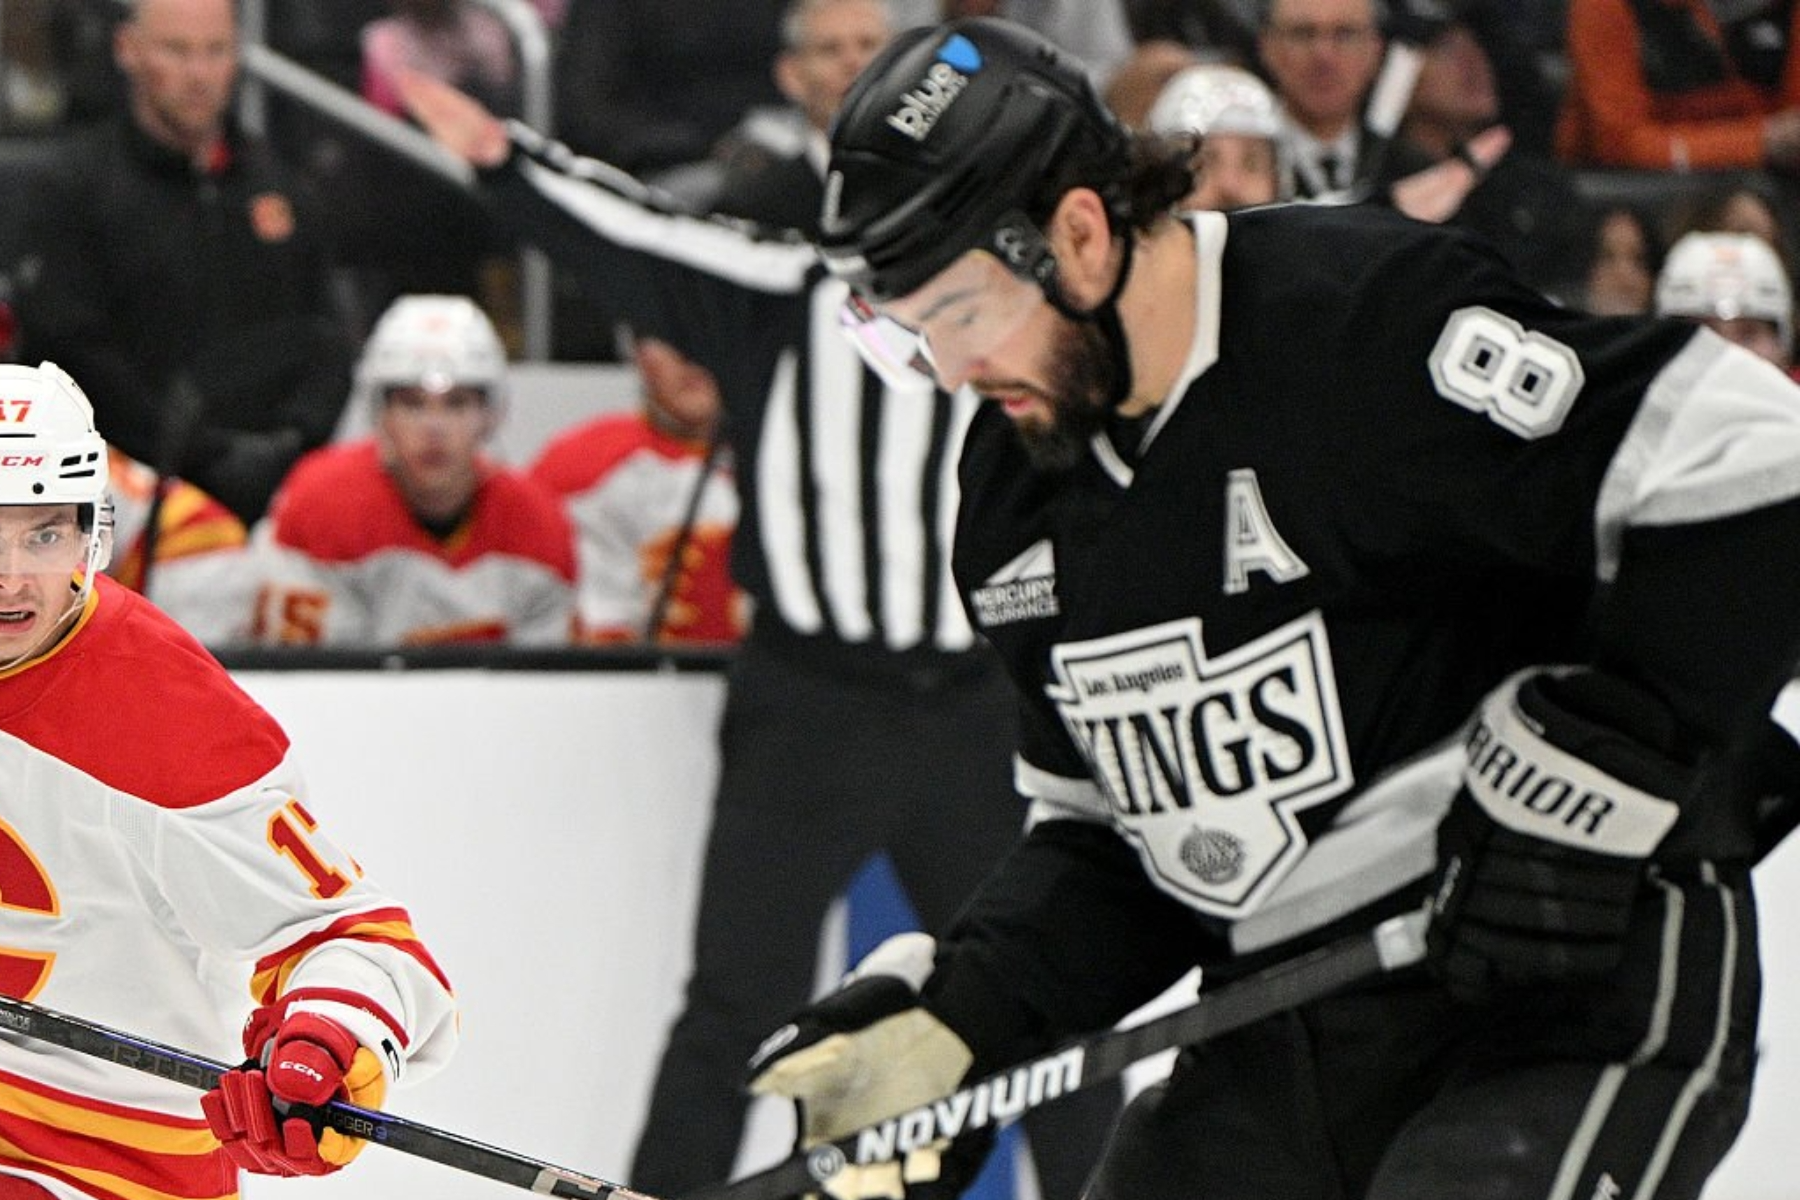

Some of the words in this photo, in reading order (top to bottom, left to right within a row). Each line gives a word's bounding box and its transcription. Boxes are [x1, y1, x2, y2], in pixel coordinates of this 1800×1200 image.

[885, 63, 954, 137] blue
[1427, 304, 1586, 441] 8
[1223, 467, 1311, 595] A
[279, 1060, 324, 1082] CCM
[856, 1044, 1086, 1164] NOVIUM
